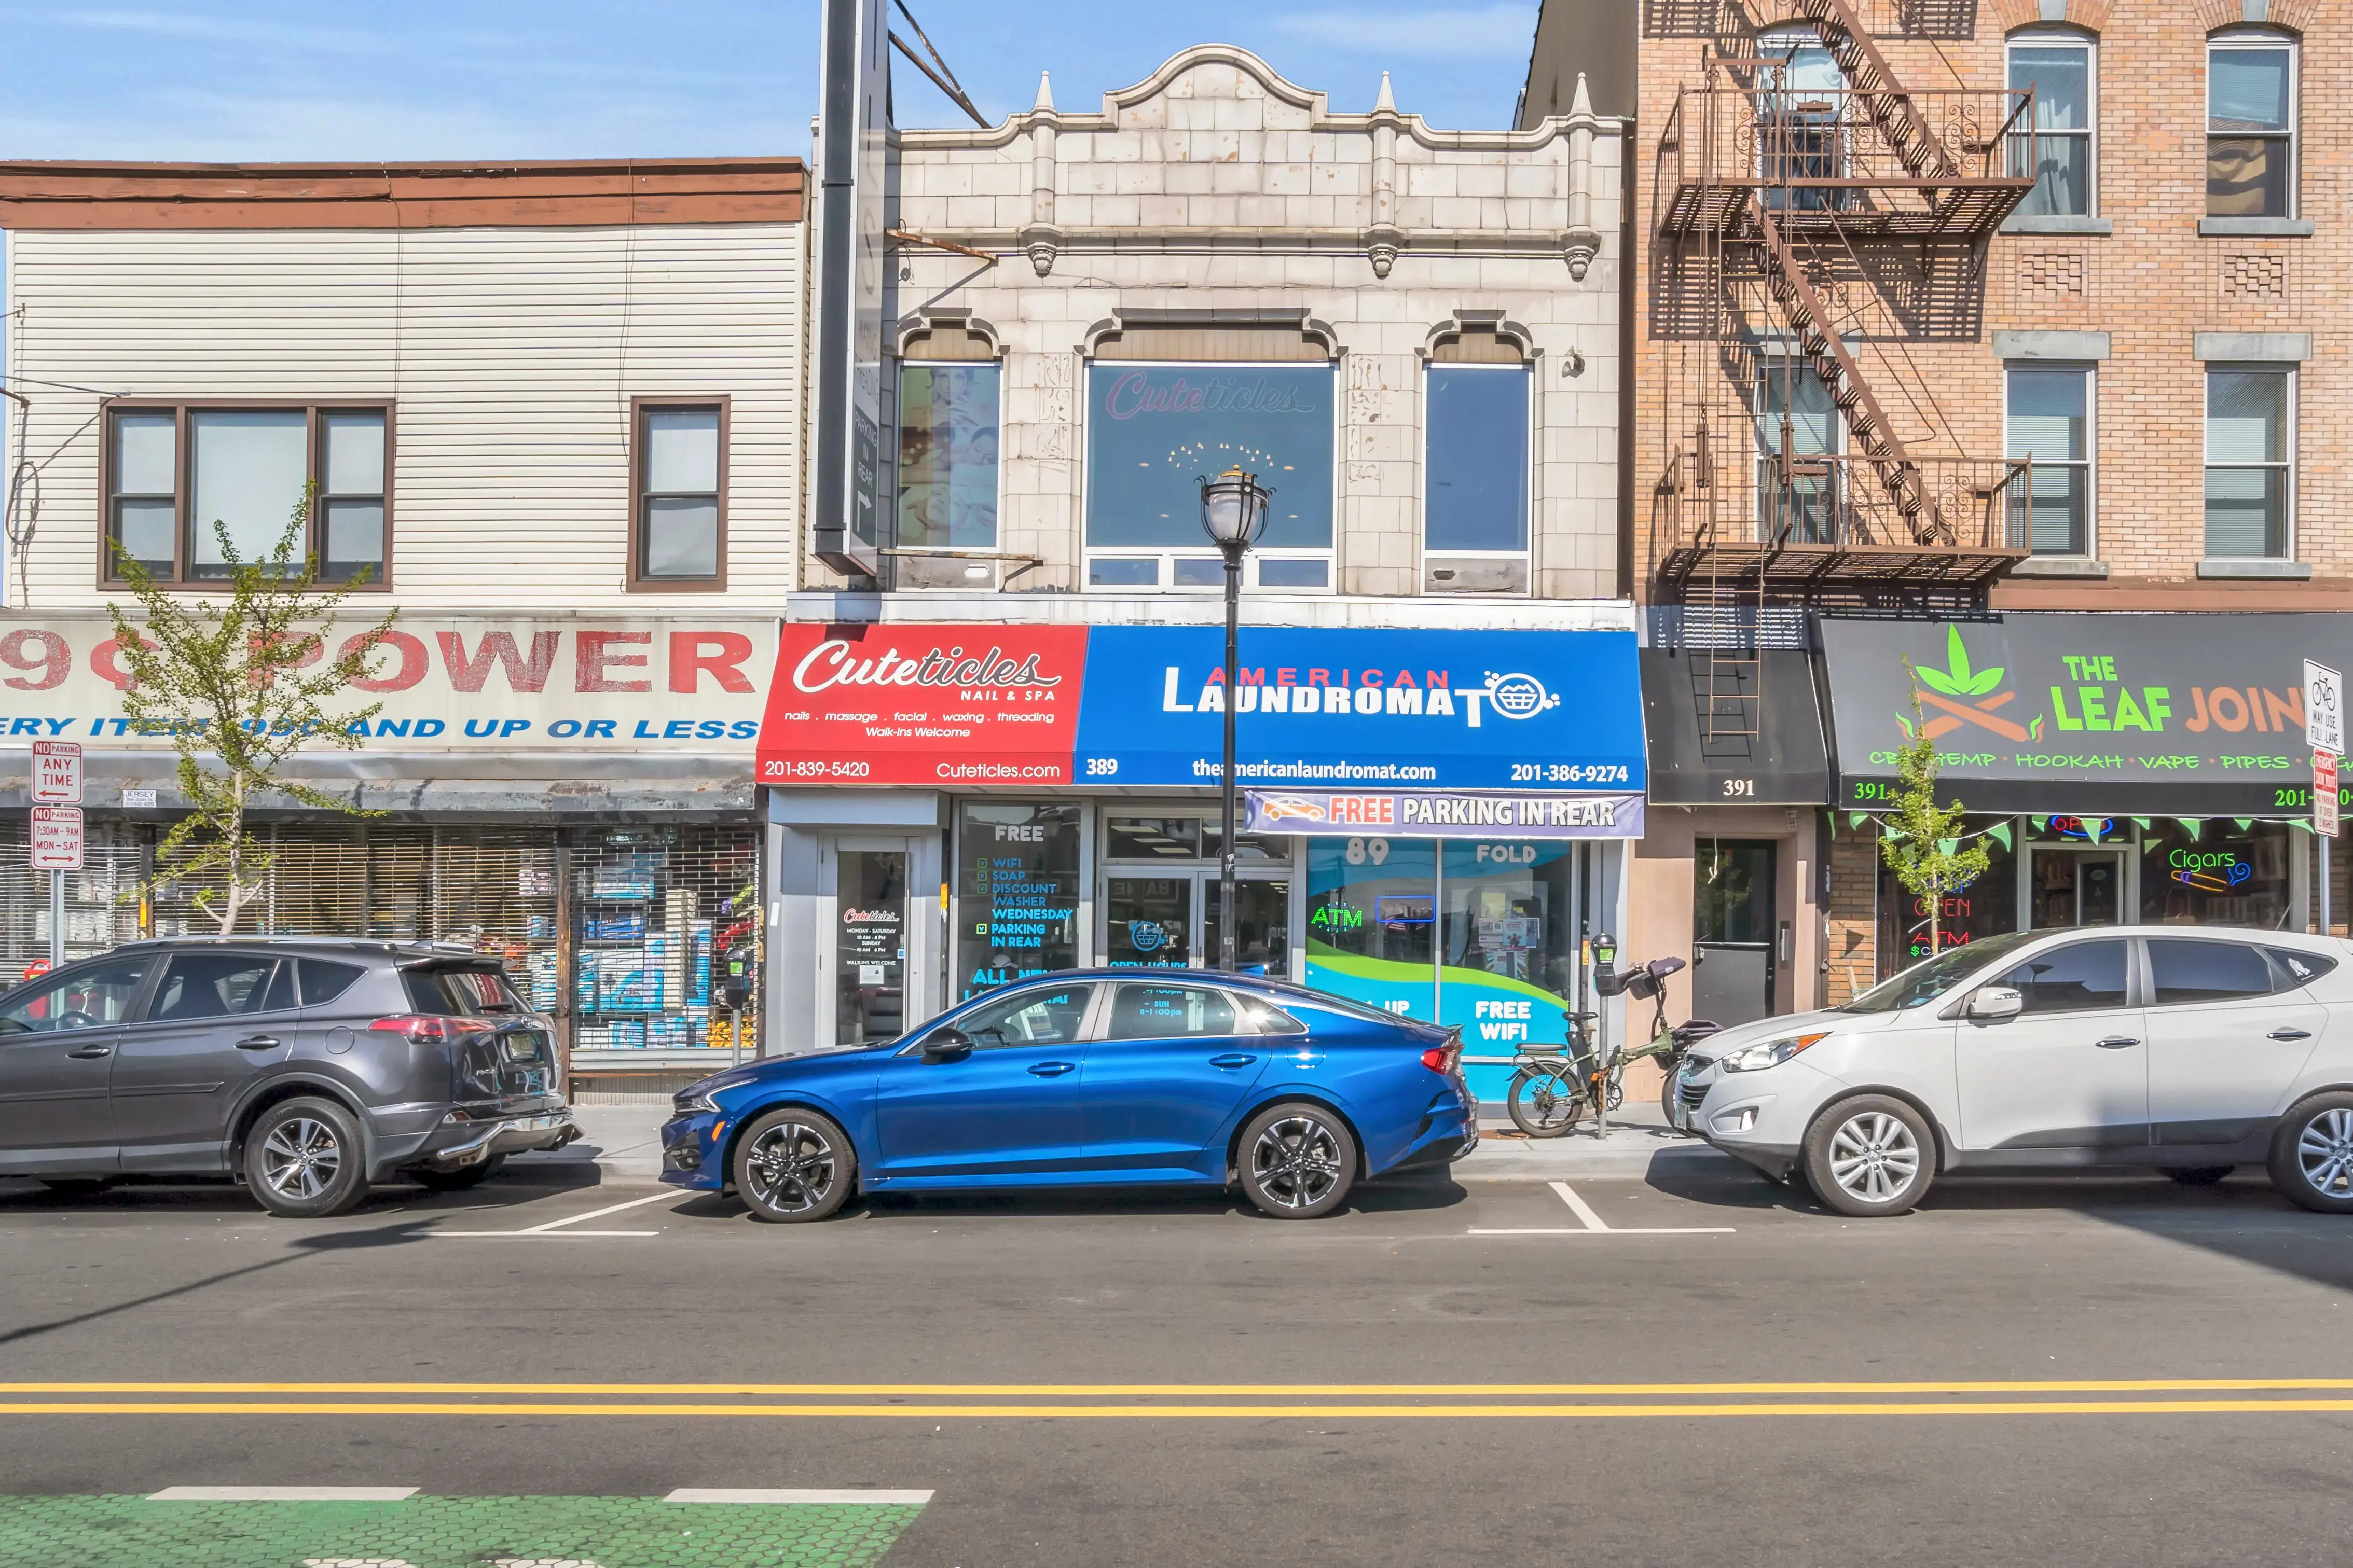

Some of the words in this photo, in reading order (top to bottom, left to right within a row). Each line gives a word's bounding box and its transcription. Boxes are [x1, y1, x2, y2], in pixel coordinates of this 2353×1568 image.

[1106, 370, 1317, 420] Cuteticles
[856, 411, 878, 448] PARKING
[862, 442, 869, 462] IN
[858, 461, 873, 489] REAR
[247, 630, 756, 693] POWER
[793, 640, 1061, 693] Cuteticles
[2062, 656, 2118, 681] THE
[1206, 667, 1449, 689] AMERICAN
[960, 691, 998, 701] NAIL
[1007, 691, 1015, 701] &
[1025, 691, 1055, 701] SPA
[1163, 667, 1491, 727] LAUNDROMAT
[2050, 686, 2172, 731] LEAF
[2185, 686, 2305, 732] JOIN
[784, 711, 810, 721] nails
[825, 712, 878, 724] massage
[893, 712, 927, 722] facial
[942, 712, 984, 724] waxing
[997, 711, 1054, 725] threading
[2313, 709, 2323, 725] MAY
[2325, 713, 2336, 729] USE
[346, 718, 446, 737] AND
[464, 719, 531, 737] UP
[547, 719, 617, 738] OR
[632, 720, 760, 739] LESS
[865, 727, 912, 737] Walk-ins
[915, 727, 971, 738] Welcome
[2311, 726, 2323, 741] FULL
[2325, 730, 2338, 746] LANE
[35, 743, 49, 754] NO
[43, 759, 72, 770] ANY
[1869, 751, 1903, 764] CB
[2016, 754, 2124, 768] HOOKAH
[2139, 755, 2199, 769] VAPE
[2220, 755, 2290, 769] PIPES
[765, 761, 870, 777] 201-839-5420
[936, 762, 1061, 779] Cuteticles.com
[1086, 758, 1118, 775] 389
[1511, 764, 1628, 782] 201-386-9274
[42, 774, 73, 786] TIME
[1723, 779, 1754, 796] 391
[1854, 783, 1886, 799] 391
[36, 809, 49, 820] NO
[1329, 796, 1394, 825] FREE
[1402, 798, 1513, 826] PARKING
[1518, 800, 1545, 826] IN
[1550, 801, 1616, 827] REAR
[36, 826, 59, 835] 7:30AM
[66, 827, 79, 836] 9AM
[995, 825, 1044, 842] FREE
[37, 841, 54, 850] MON
[63, 842, 78, 851] SAT
[1476, 845, 1537, 863] FOLD
[993, 858, 1021, 868] WIFI
[2170, 849, 2235, 872] Cigars
[993, 871, 1025, 881] SOAP
[992, 883, 1056, 894] DISCOUNT
[993, 896, 1046, 907] WASHER
[844, 908, 900, 923] Cuteticles
[992, 908, 1073, 920] WEDNESDAY
[1311, 907, 1363, 927] ATM
[992, 924, 1046, 934] PARKING
[991, 936, 1006, 947] IN
[1008, 936, 1041, 947] REAR
[1911, 931, 1970, 946] ATM
[972, 969, 1010, 984] ALL
[1475, 1001, 1532, 1019] FREE
[1479, 1022, 1528, 1041] WIFI
